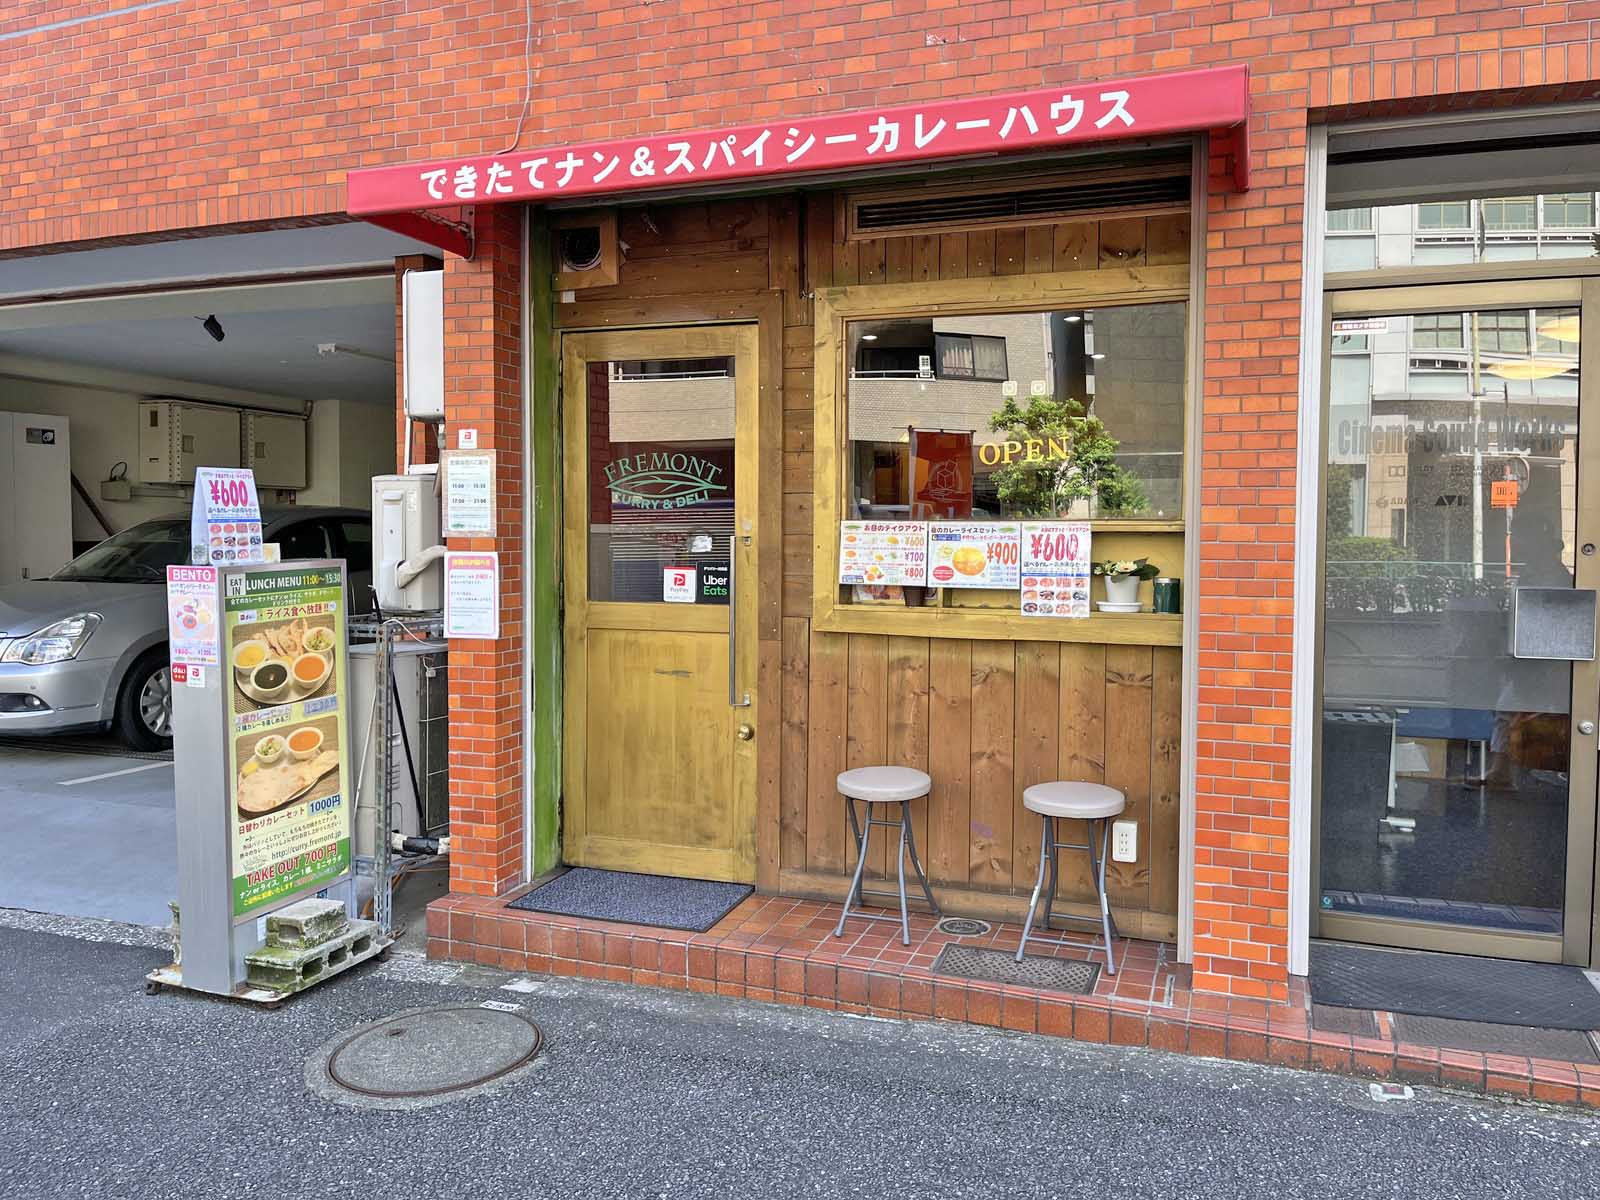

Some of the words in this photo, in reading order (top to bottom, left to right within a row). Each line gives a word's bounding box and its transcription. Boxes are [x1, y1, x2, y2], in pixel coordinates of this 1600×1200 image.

[420, 89, 1136, 200] できたてナン&スパイシーカレーハウス
[1338, 419, 1416, 456] Cinema
[1423, 416, 1489, 453] Sound
[1500, 414, 1567, 452] Works
[979, 436, 1071, 466] OPEN
[603, 452, 723, 484] FREMONT
[208, 480, 248, 507] ¥600
[611, 491, 659, 510] CURRY
[663, 500, 674, 510] &
[677, 489, 709, 508] DELI
[904, 536, 925, 547] ¥600
[1030, 533, 1079, 561] ¥600
[904, 551, 924, 562] ¥700
[987, 542, 1018, 565] ¥900
[172, 569, 212, 581] BENTO
[704, 575, 728, 585] Uber
[904, 567, 924, 578] ¥800
[230, 579, 242, 587] EAT
[232, 586, 241, 595] IN
[246, 579, 275, 591] LUNCH
[277, 576, 301, 588] MENU
[704, 586, 728, 596] Eats
[311, 794, 341, 813] 1000円
[271, 831, 342, 860] http://curry.fremont.jp
[247, 868, 275, 887] TAKE
[277, 856, 300, 875] OUT
